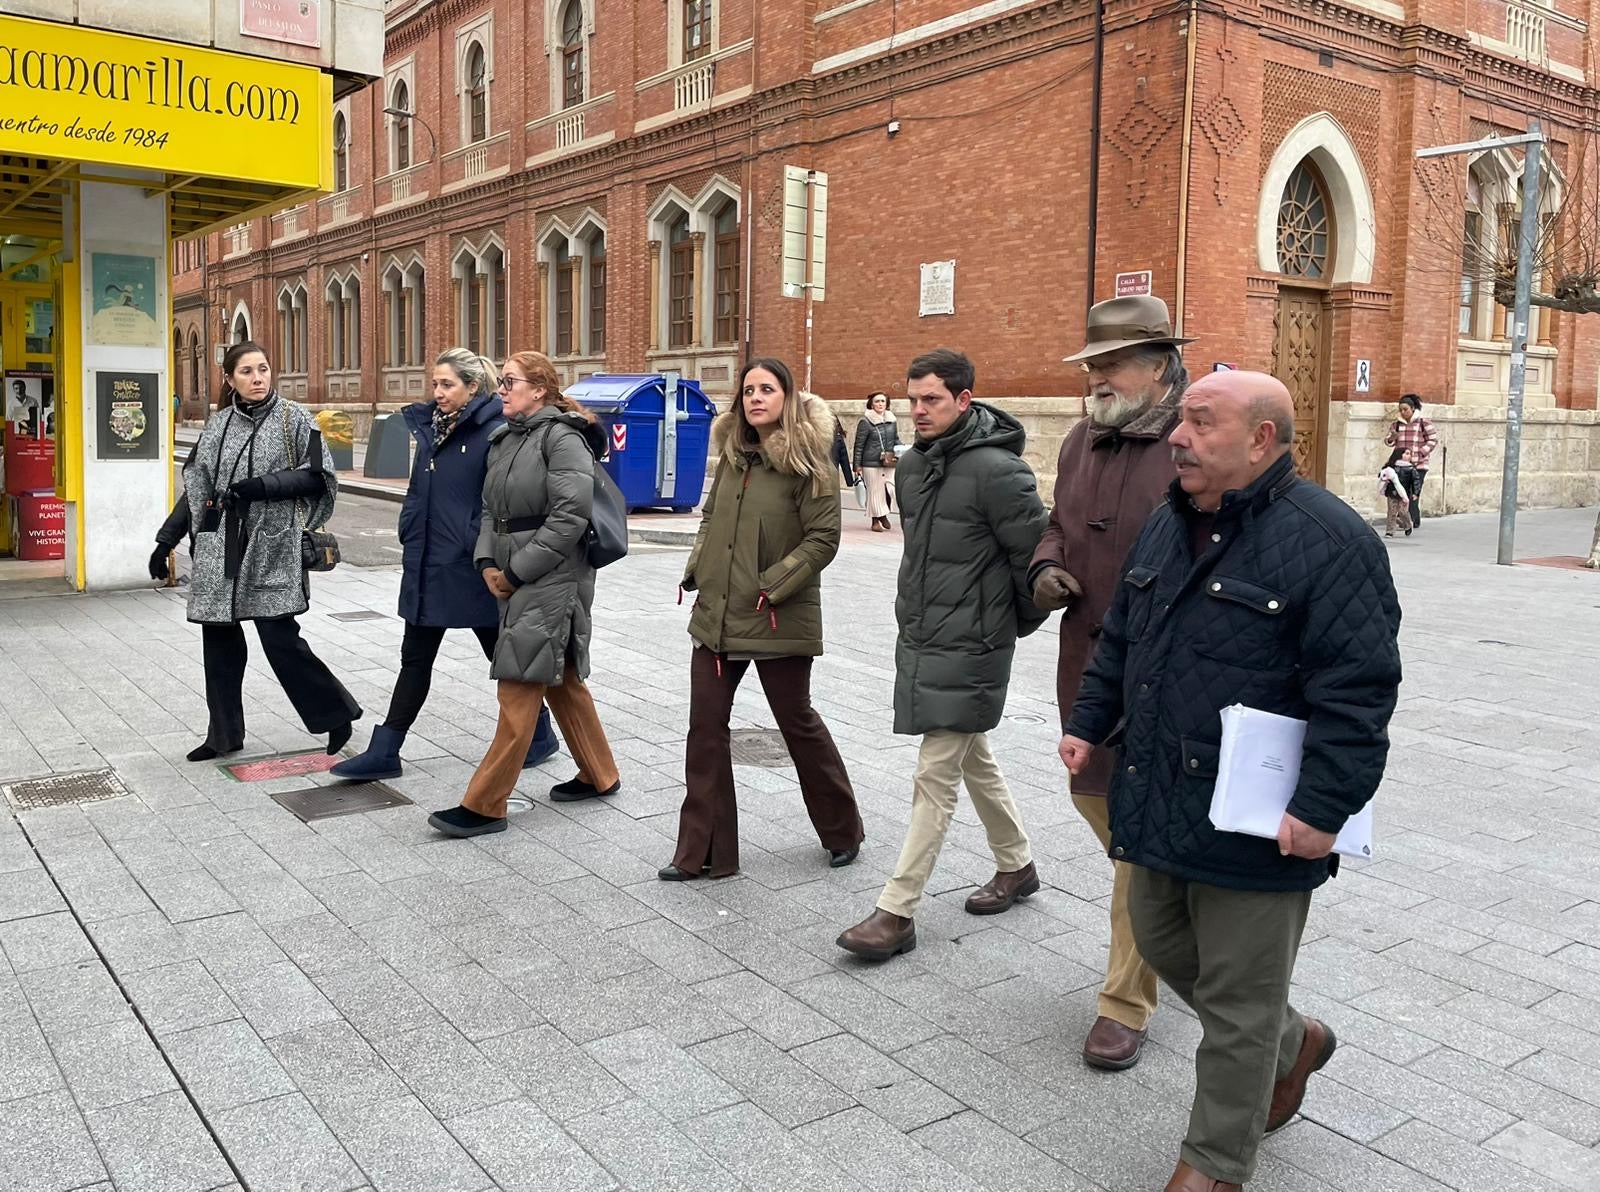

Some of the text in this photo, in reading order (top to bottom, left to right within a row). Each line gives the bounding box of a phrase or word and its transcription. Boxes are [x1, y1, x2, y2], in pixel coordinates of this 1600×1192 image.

[64, 117, 117, 143] desde
[123, 128, 170, 149] 1984
[39, 511, 66, 519] PLANET
[28, 529, 46, 537] VIVE
